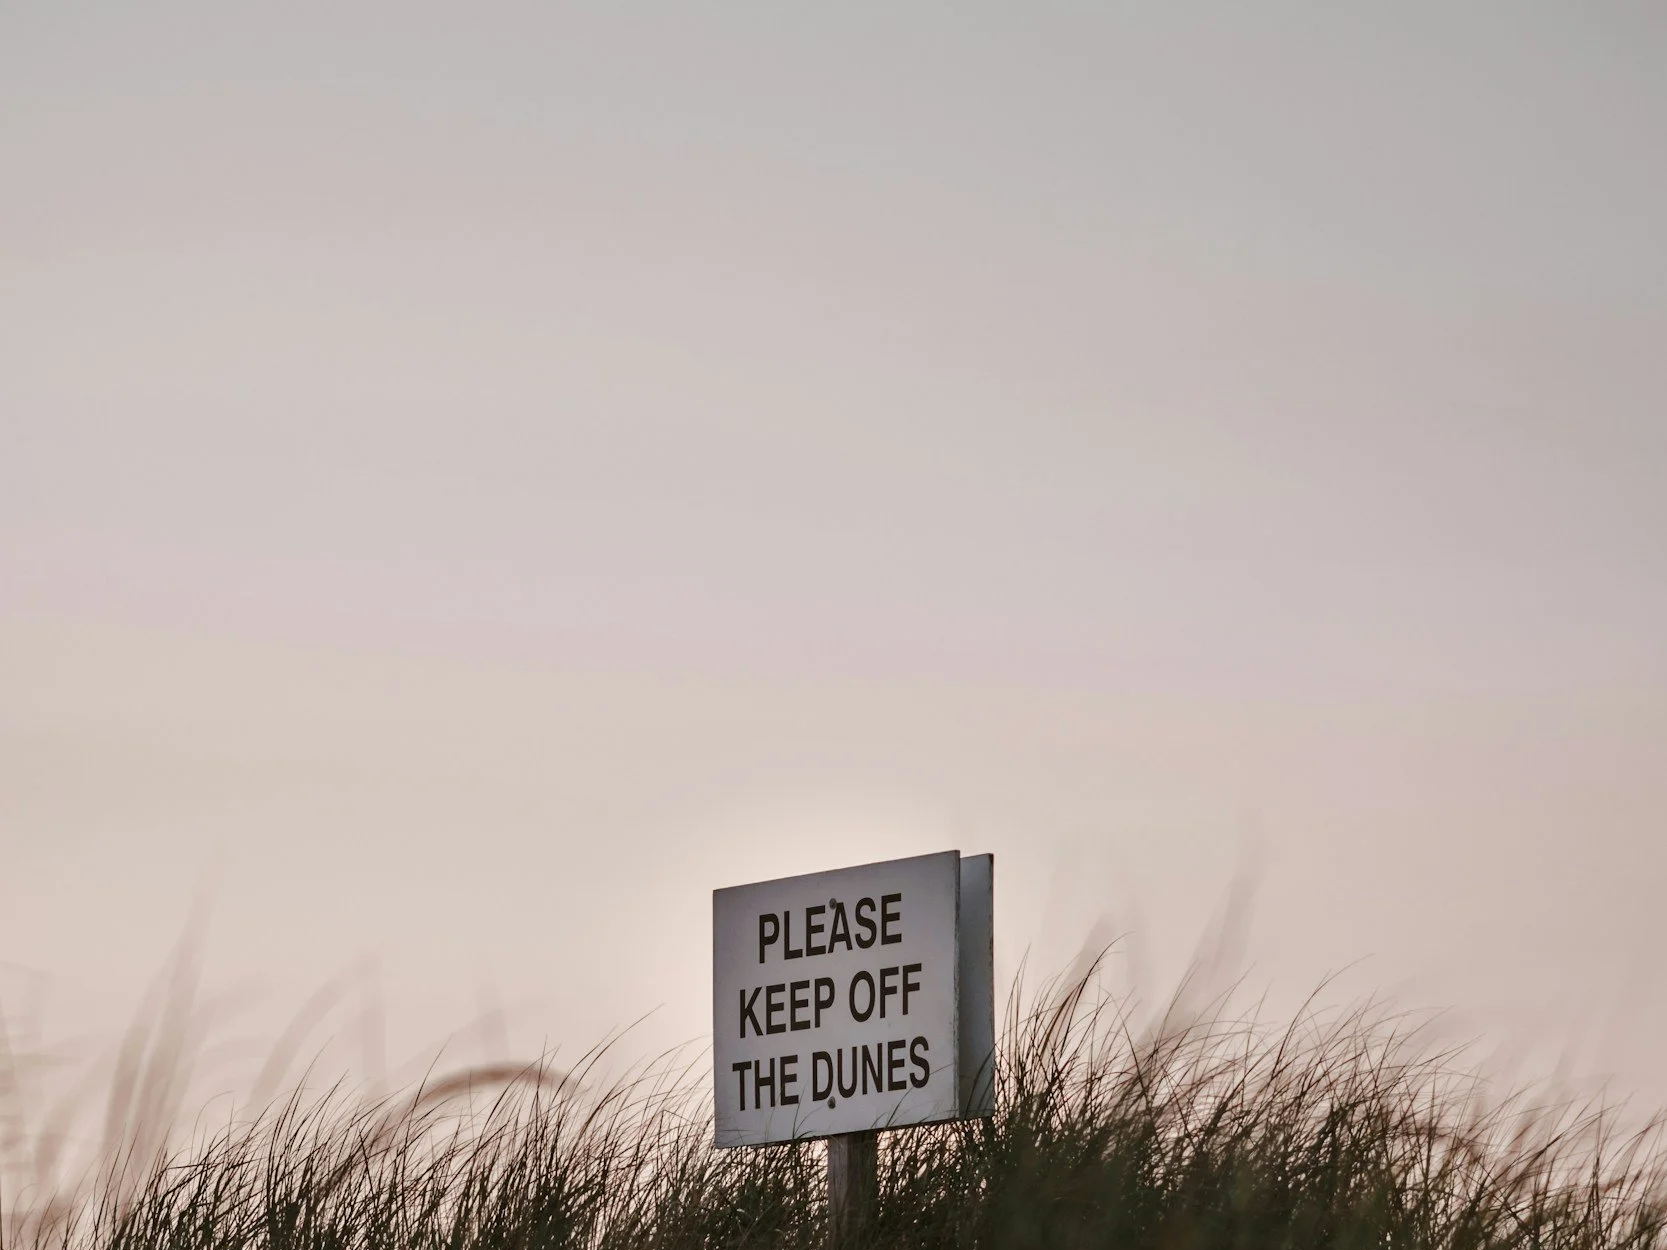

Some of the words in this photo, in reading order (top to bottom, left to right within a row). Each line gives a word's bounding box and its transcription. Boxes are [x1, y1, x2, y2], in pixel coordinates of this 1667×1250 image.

[758, 892, 903, 965] PLEASE
[739, 976, 836, 1039] KEEP
[848, 962, 923, 1024] OFF
[731, 1054, 800, 1112] THE
[811, 1035, 931, 1102] DUNES
